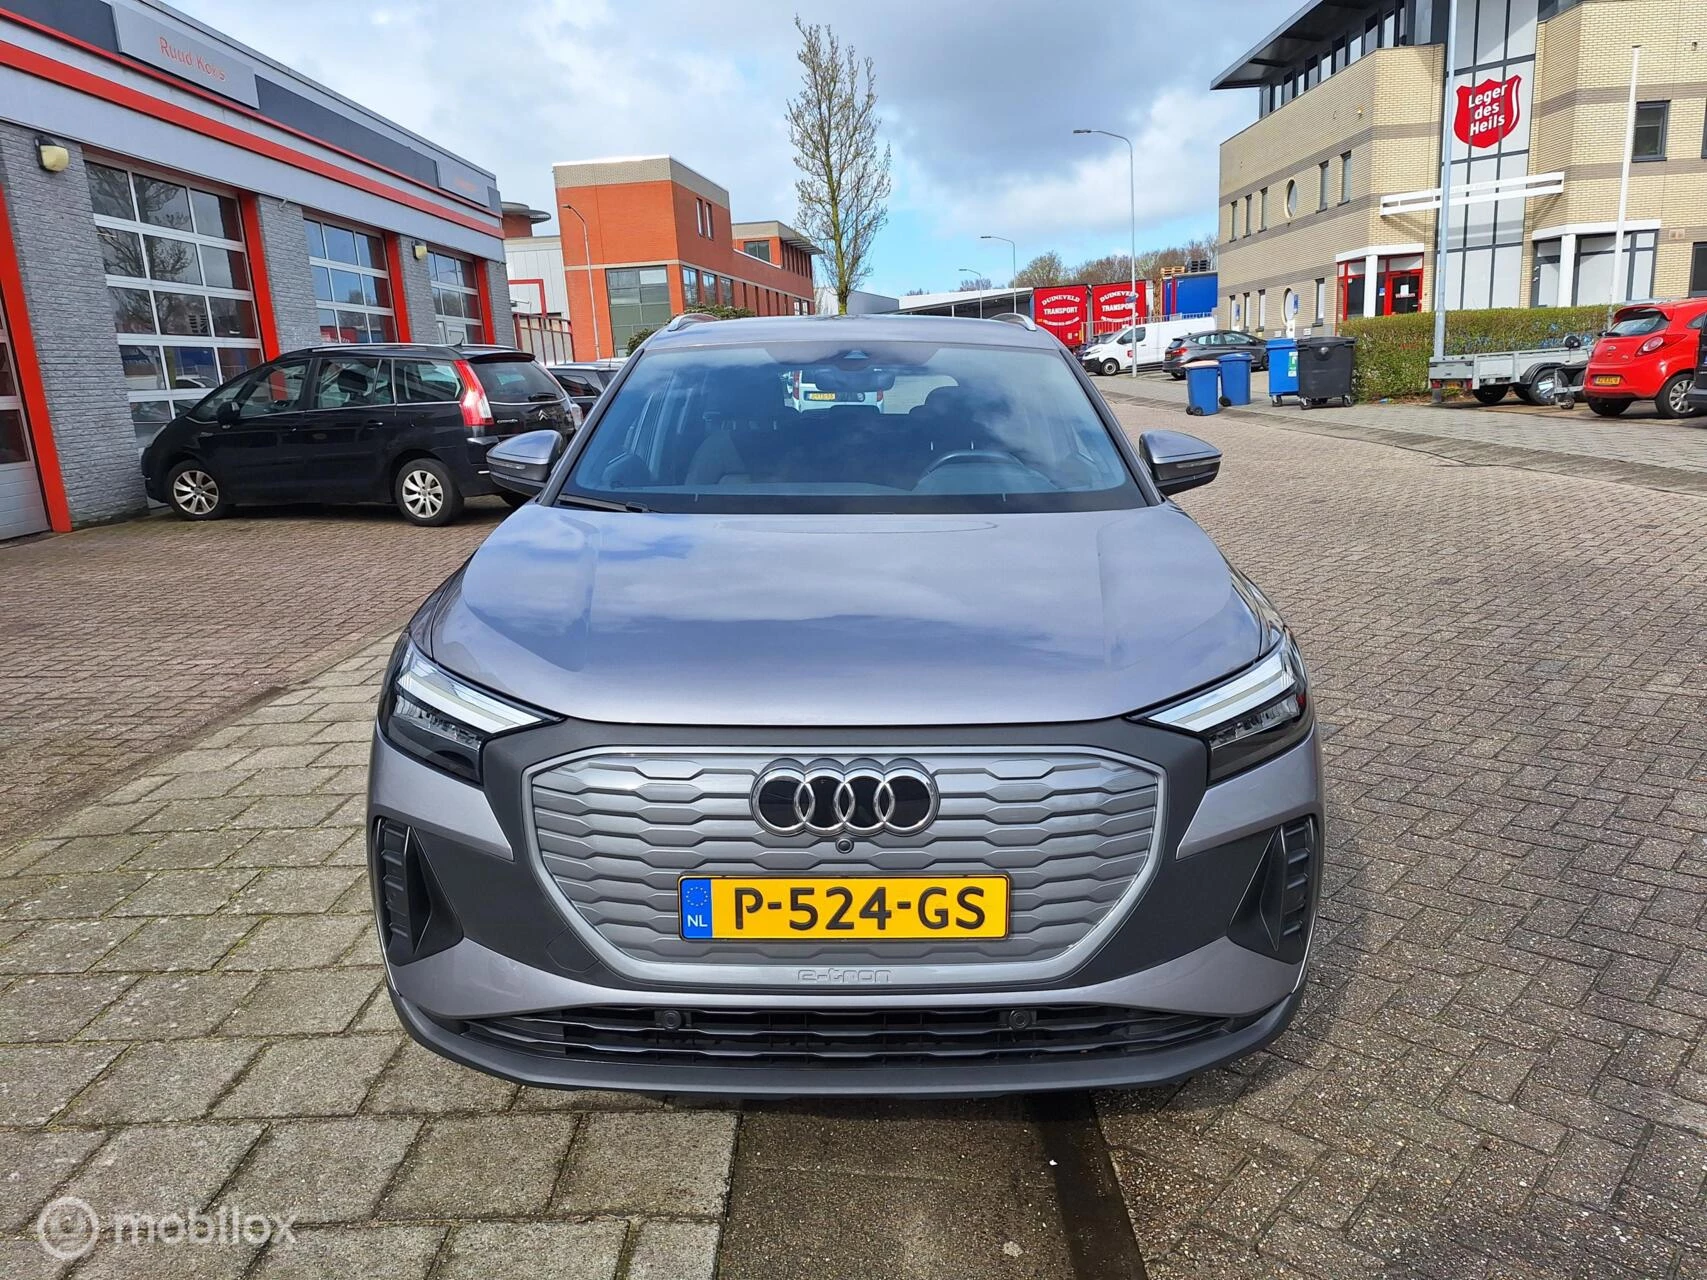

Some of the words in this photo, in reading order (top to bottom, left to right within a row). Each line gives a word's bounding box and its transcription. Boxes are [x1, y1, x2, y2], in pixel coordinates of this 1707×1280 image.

[159, 36, 193, 66] Ruud
[1468, 84, 1508, 109] Leger
[1474, 102, 1500, 120] des
[1469, 115, 1506, 136] Heils
[1041, 294, 1080, 306] DUINEVELD
[1100, 290, 1139, 303] DUINEVED
[1043, 306, 1079, 315] TRANSPORT
[687, 914, 708, 928] NL
[734, 886, 986, 932] P-524-GS
[797, 967, 893, 984] e-tron
